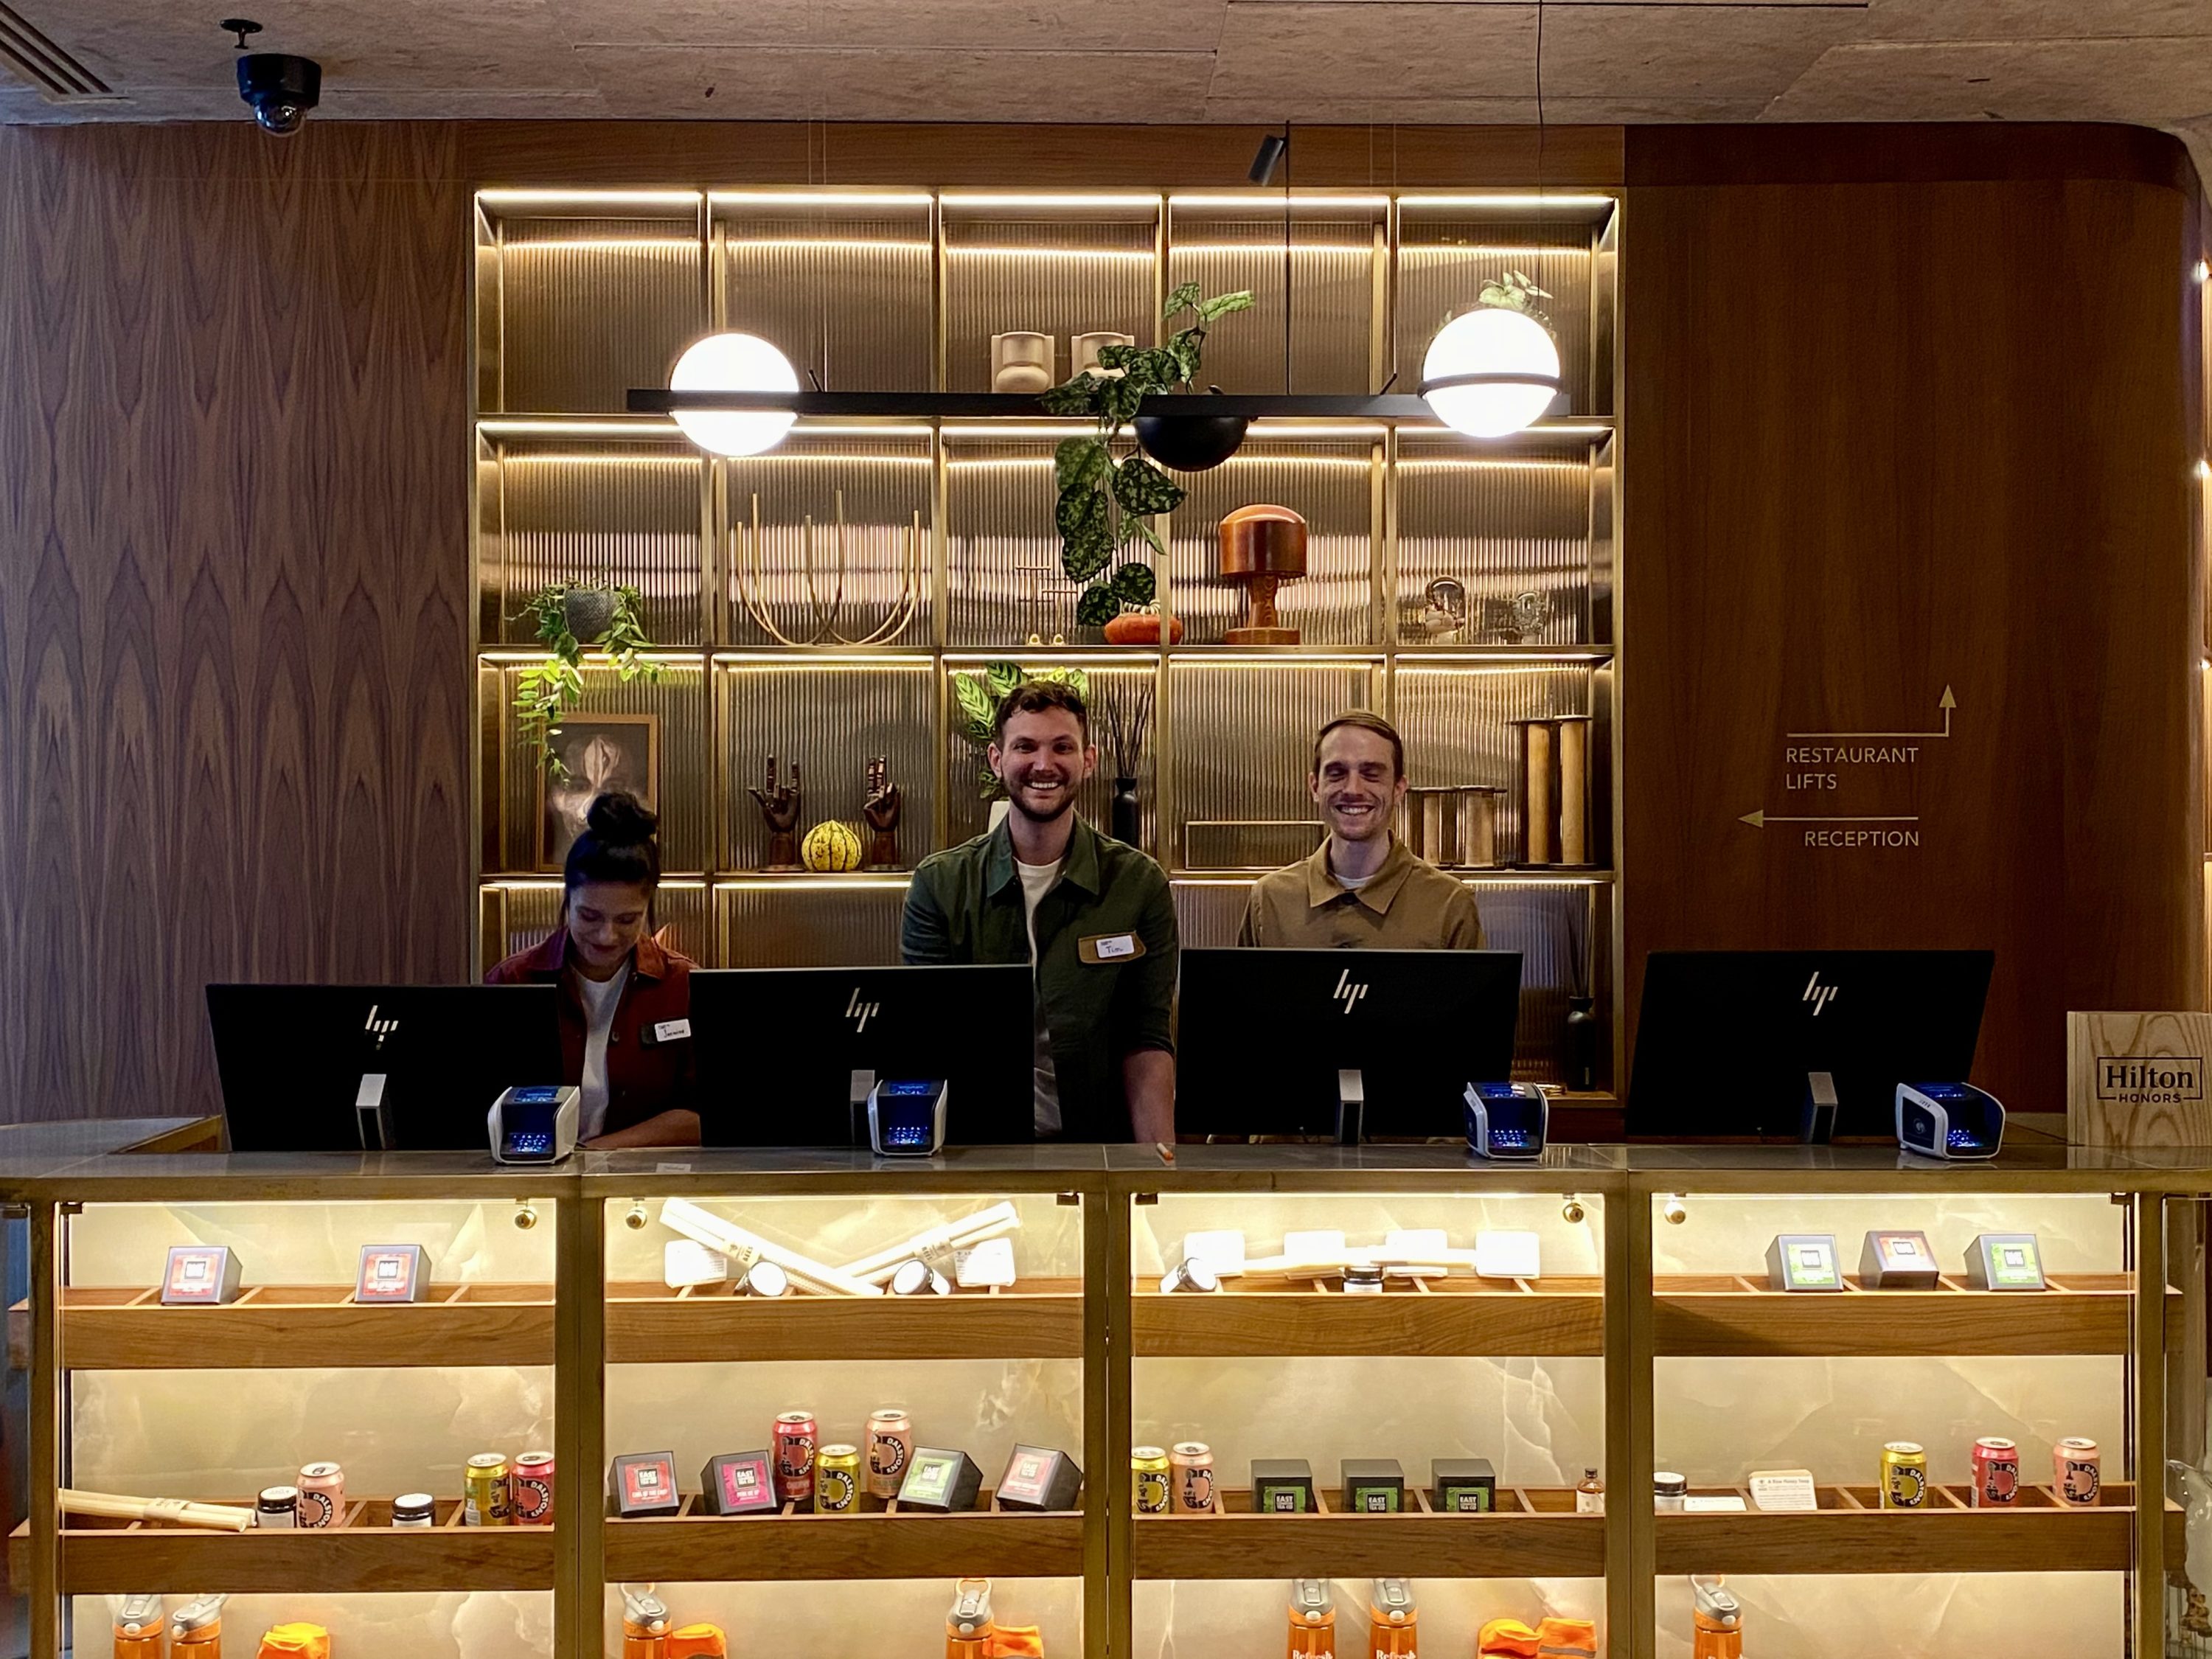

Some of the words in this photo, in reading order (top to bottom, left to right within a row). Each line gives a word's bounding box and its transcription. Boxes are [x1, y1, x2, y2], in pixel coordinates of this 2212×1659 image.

[1786, 747, 1919, 763] RESTAURANT
[1786, 773, 1837, 790] LIFTS
[1804, 831, 1919, 847] RECEPTION
[1333, 968, 1368, 1015] hp
[1802, 971, 1838, 1016] hp
[845, 988, 880, 1033] hp
[2106, 1065, 2194, 1088] Hilton
[2118, 1093, 2182, 1104] HONORS
[887, 1437, 903, 1473] DALSTONS
[530, 1481, 549, 1517] DALSTONS
[836, 1472, 853, 1509] DALSTONS
[1910, 1470, 1924, 1505] DALSTONS
